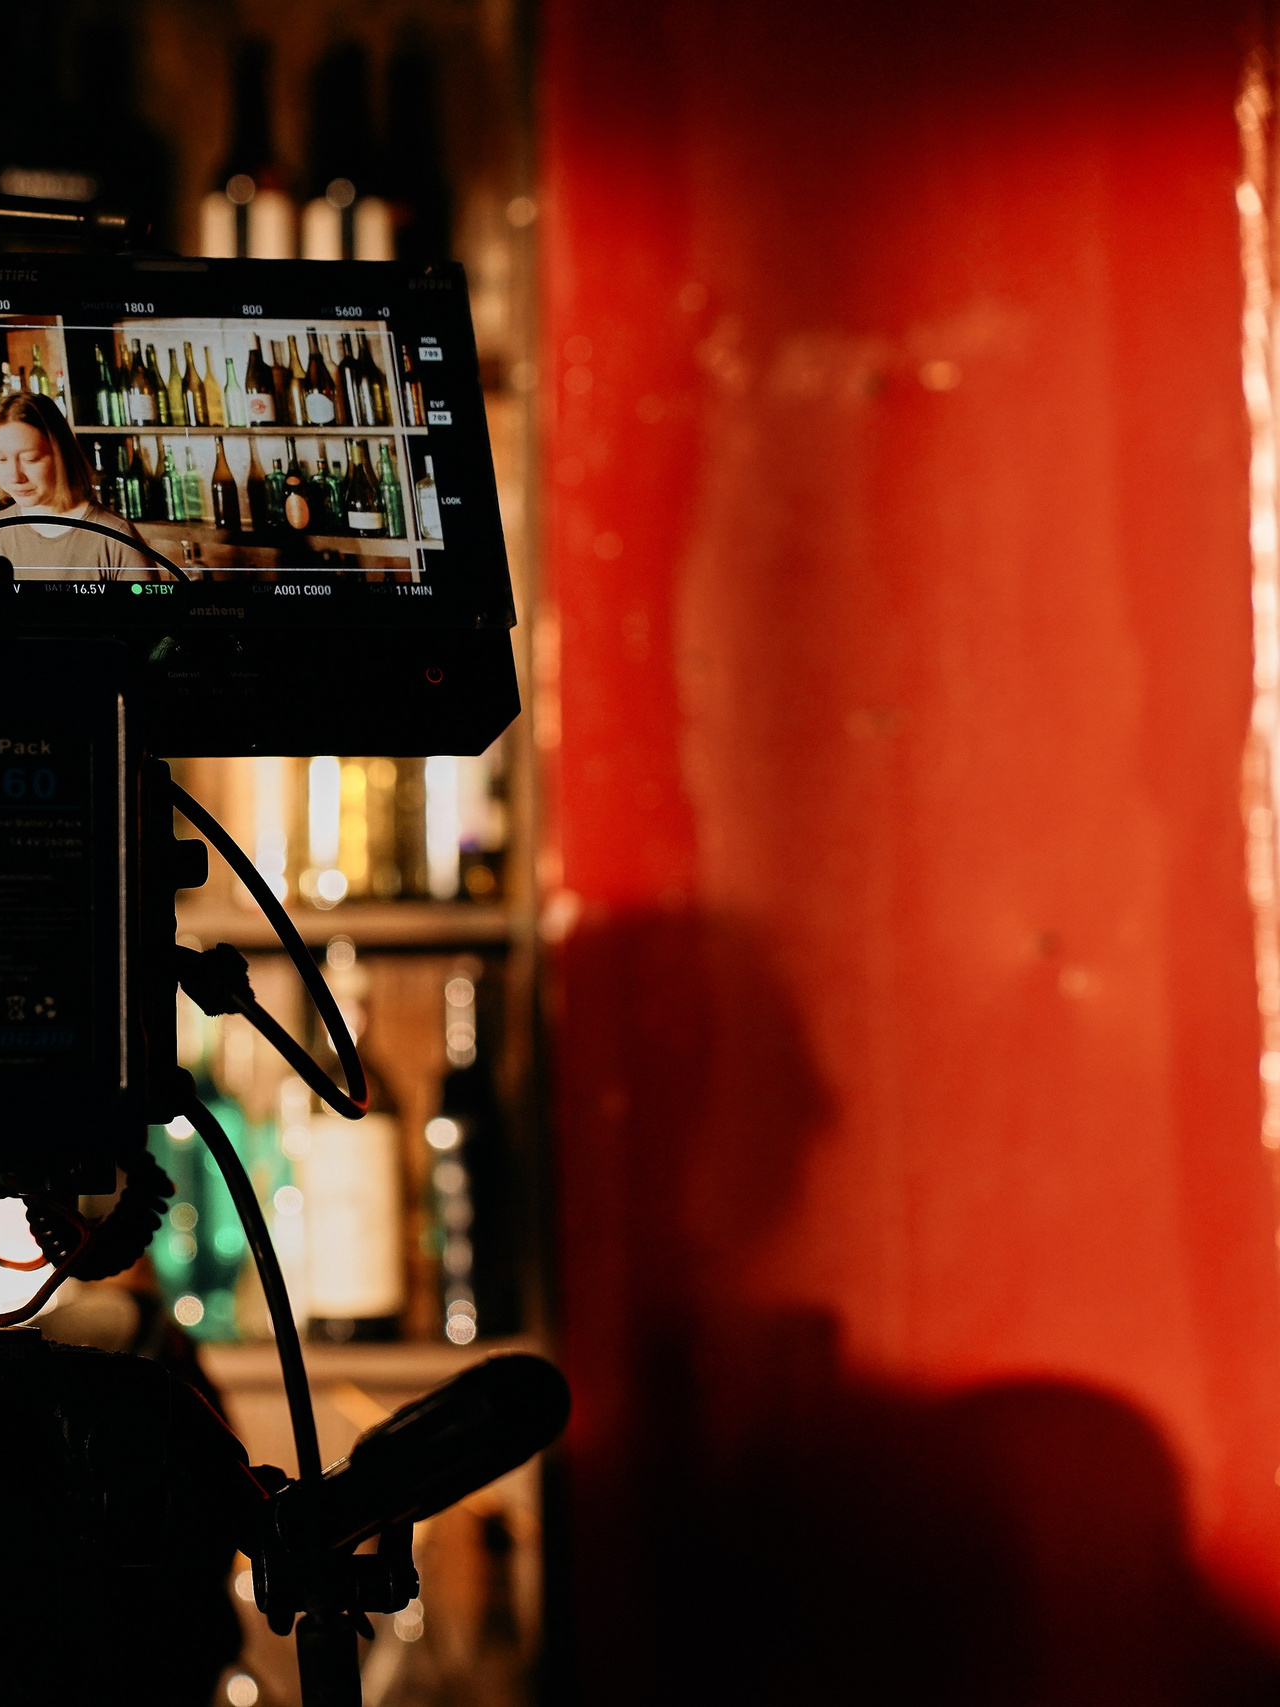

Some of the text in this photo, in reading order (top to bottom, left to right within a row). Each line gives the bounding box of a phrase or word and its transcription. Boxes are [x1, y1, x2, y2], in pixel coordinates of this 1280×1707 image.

[124, 301, 155, 314] 180.0
[241, 303, 264, 316] 800
[334, 305, 363, 318] 5600
[44, 583, 63, 593] BAT
[73, 583, 106, 595] 16.5V
[145, 583, 175, 595] STBY
[252, 584, 332, 596] CLIP A001 C000
[396, 585, 409, 596] 11
[411, 585, 433, 596] MIN
